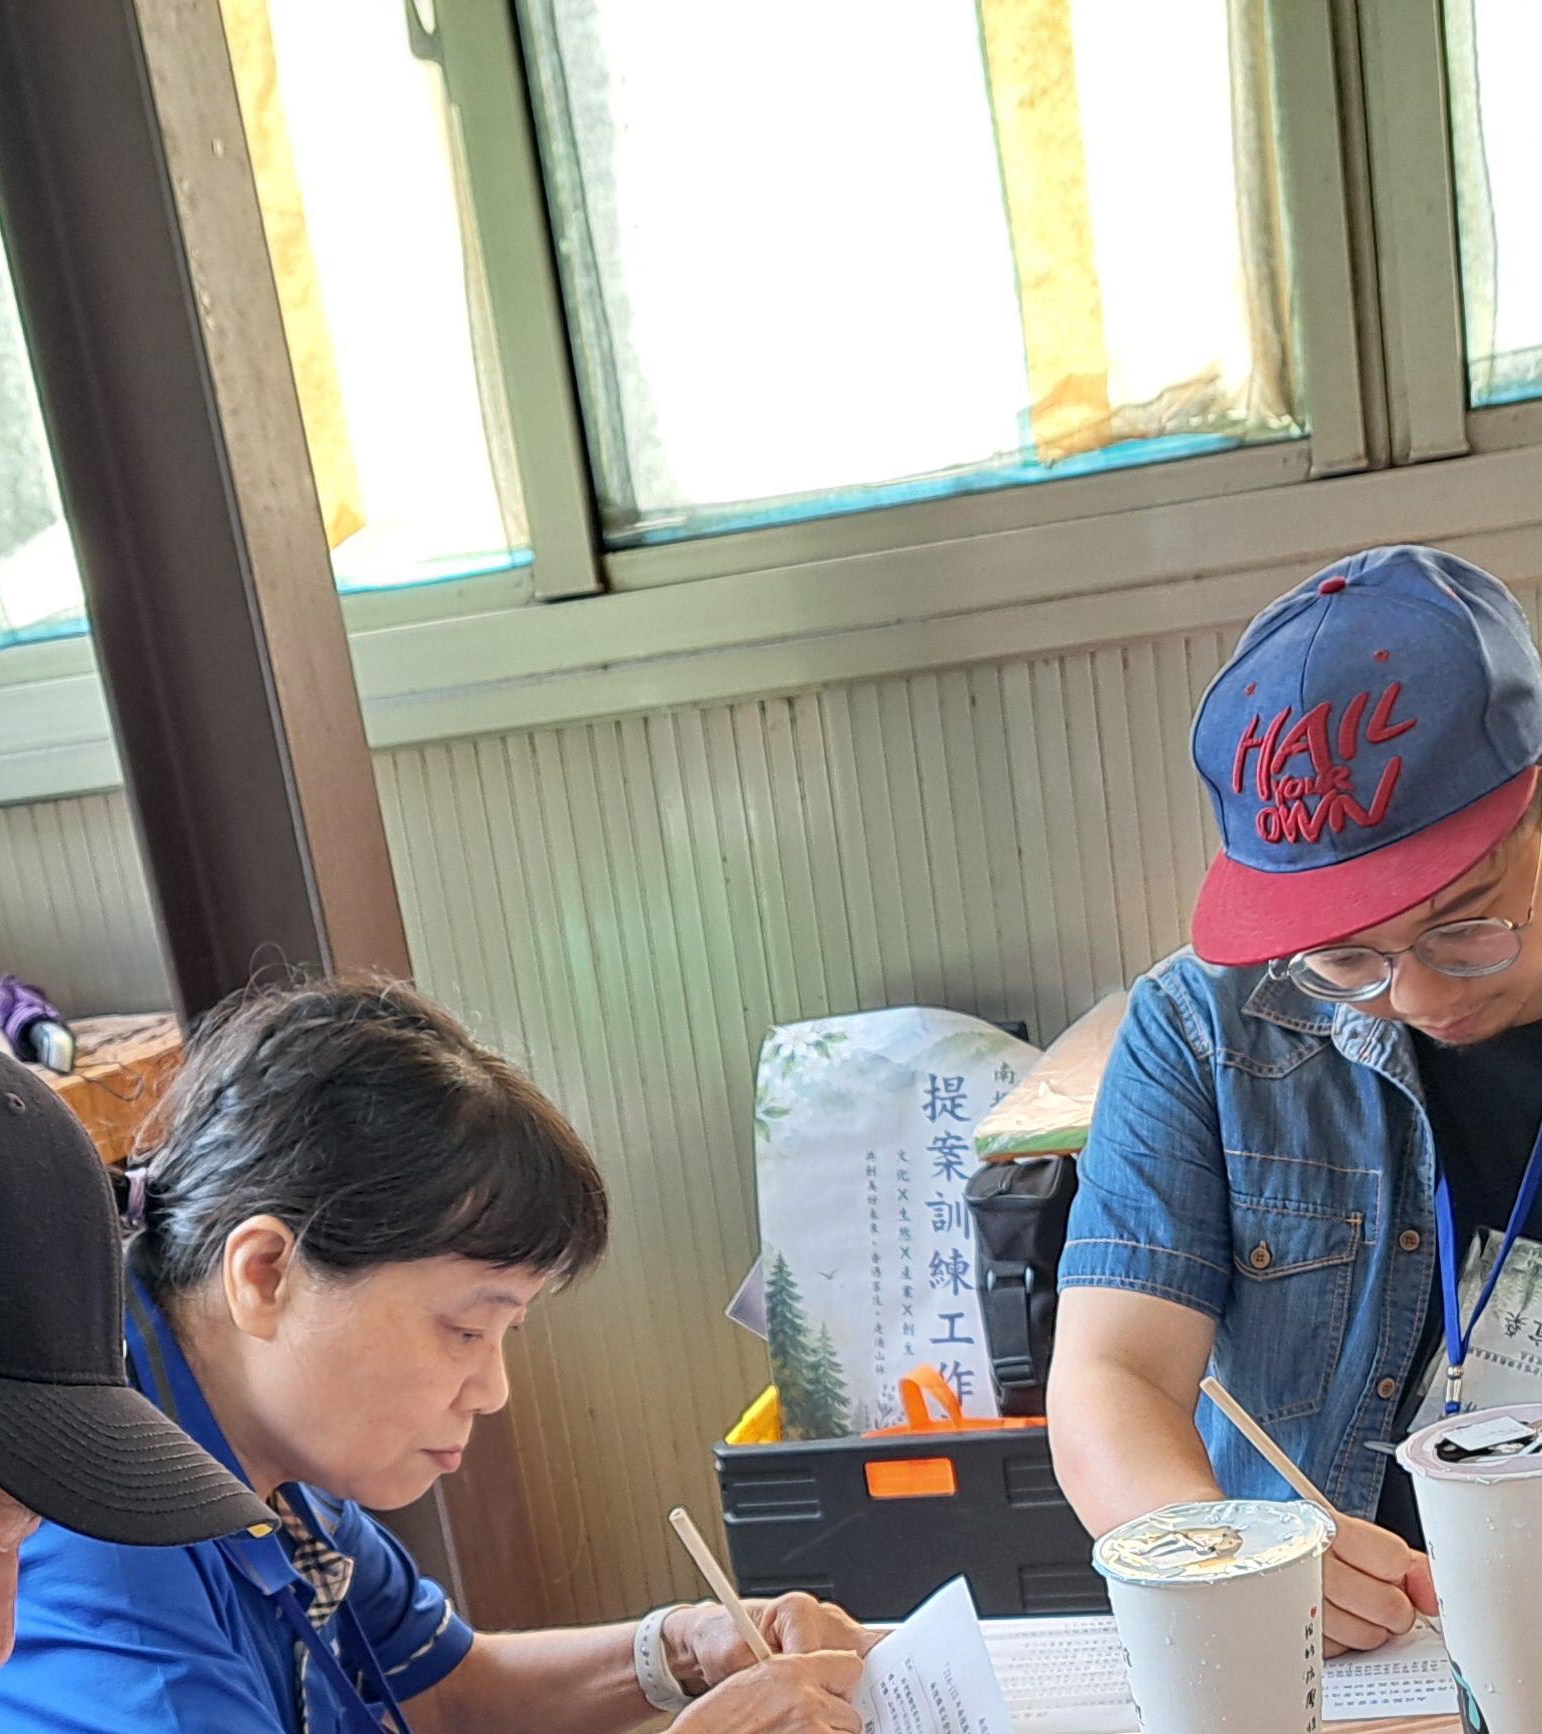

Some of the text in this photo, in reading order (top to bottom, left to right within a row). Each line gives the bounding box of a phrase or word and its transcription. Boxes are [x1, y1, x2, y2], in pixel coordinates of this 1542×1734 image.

[1233, 683, 1417, 801] HAIL
[1273, 765, 1355, 802] YOUR
[1256, 756, 1403, 844] OWN
[922, 1074, 977, 1418] 提案訓練工作
